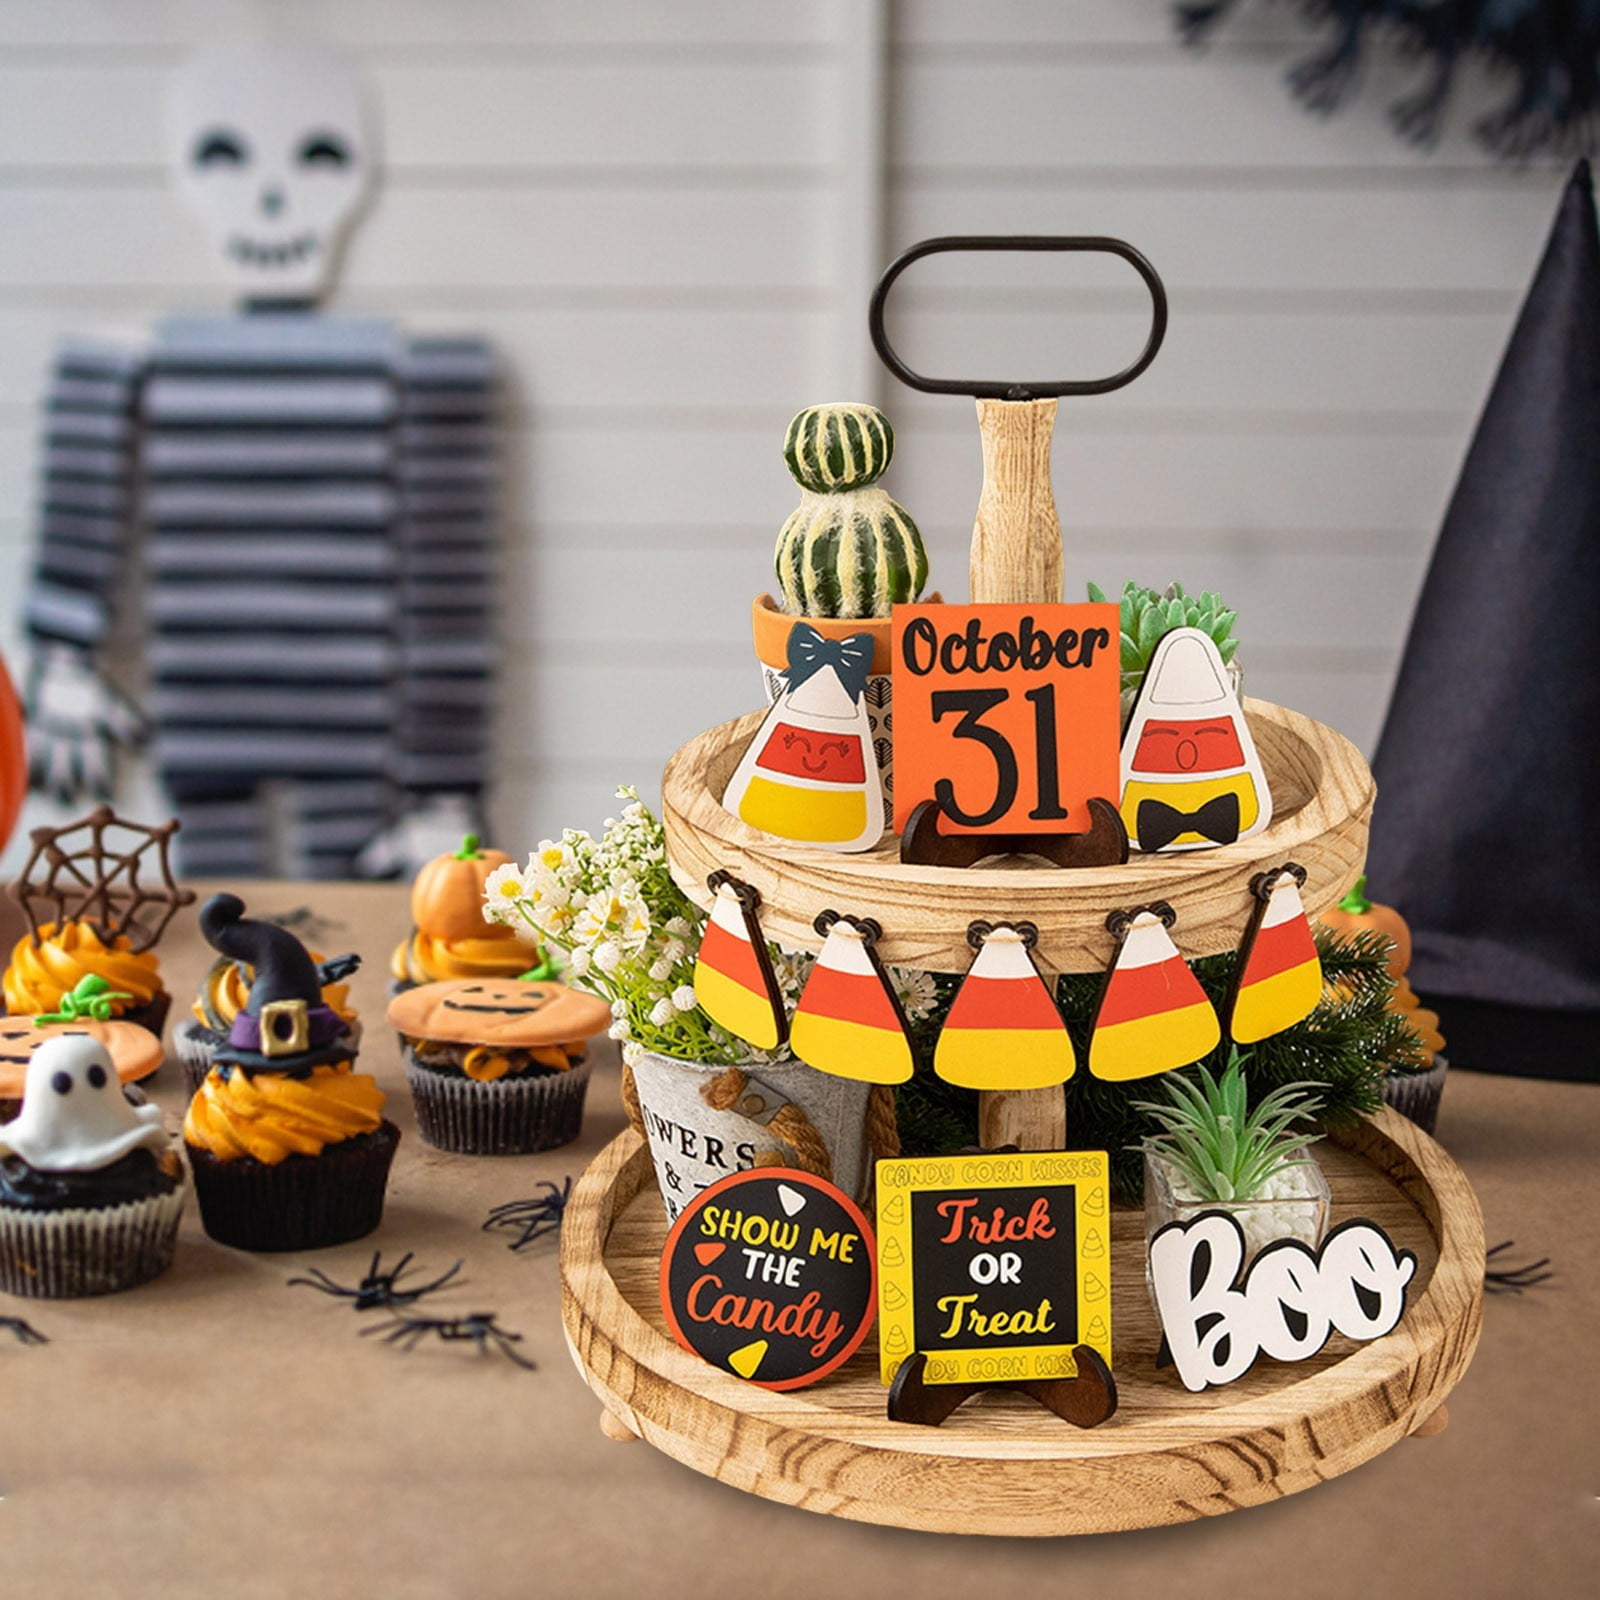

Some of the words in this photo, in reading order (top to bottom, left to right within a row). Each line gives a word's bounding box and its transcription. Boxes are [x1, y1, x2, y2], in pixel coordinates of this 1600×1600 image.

[902, 616, 1109, 676] October
[931, 683, 1068, 827] 31
[881, 1163, 954, 1187] CANDY
[961, 1161, 1023, 1183] CORN
[1030, 1157, 1102, 1181] KISSES
[701, 1206, 799, 1250] SHOW
[809, 1228, 859, 1263] ME
[936, 1197, 1056, 1244] Trick
[742, 1248, 806, 1287] THE
[969, 1252, 1022, 1285] OR
[686, 1274, 844, 1358] Candy
[936, 1293, 1056, 1339] Treat
[966, 1356, 1029, 1379] CORN
